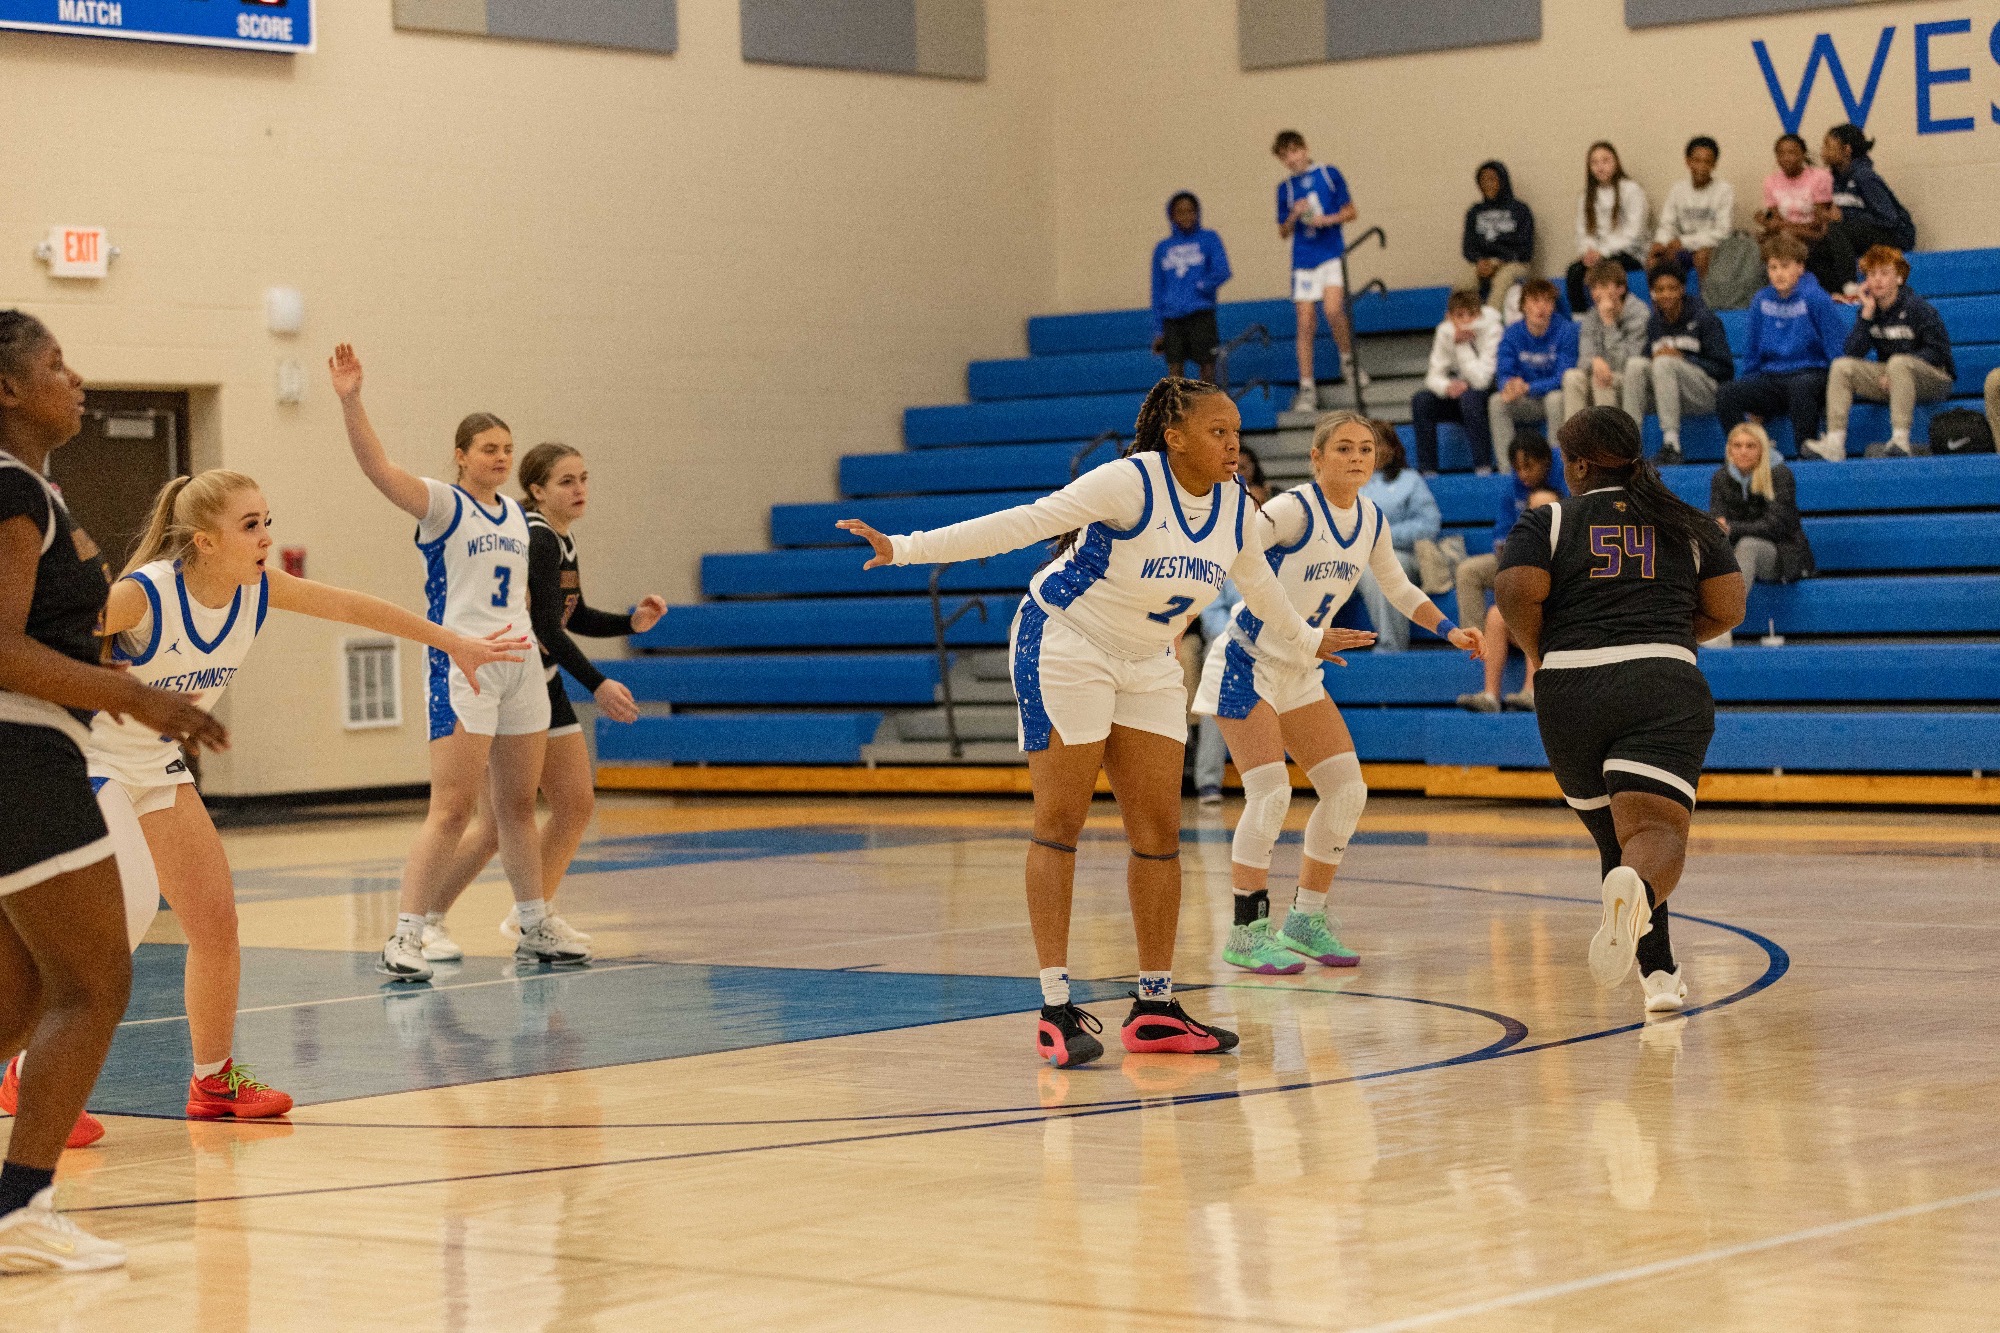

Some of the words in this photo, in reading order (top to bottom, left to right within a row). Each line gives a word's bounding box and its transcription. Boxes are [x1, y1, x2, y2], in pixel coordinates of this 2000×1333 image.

[58, 0, 122, 26] MATCH
[236, 13, 294, 41] SCORE
[1751, 18, 2000, 135] WE
[65, 231, 99, 262] EXIT
[1589, 525, 1656, 579] 54
[491, 565, 511, 607] 3
[1146, 595, 1196, 626] 2
[1306, 592, 1336, 628] 5
